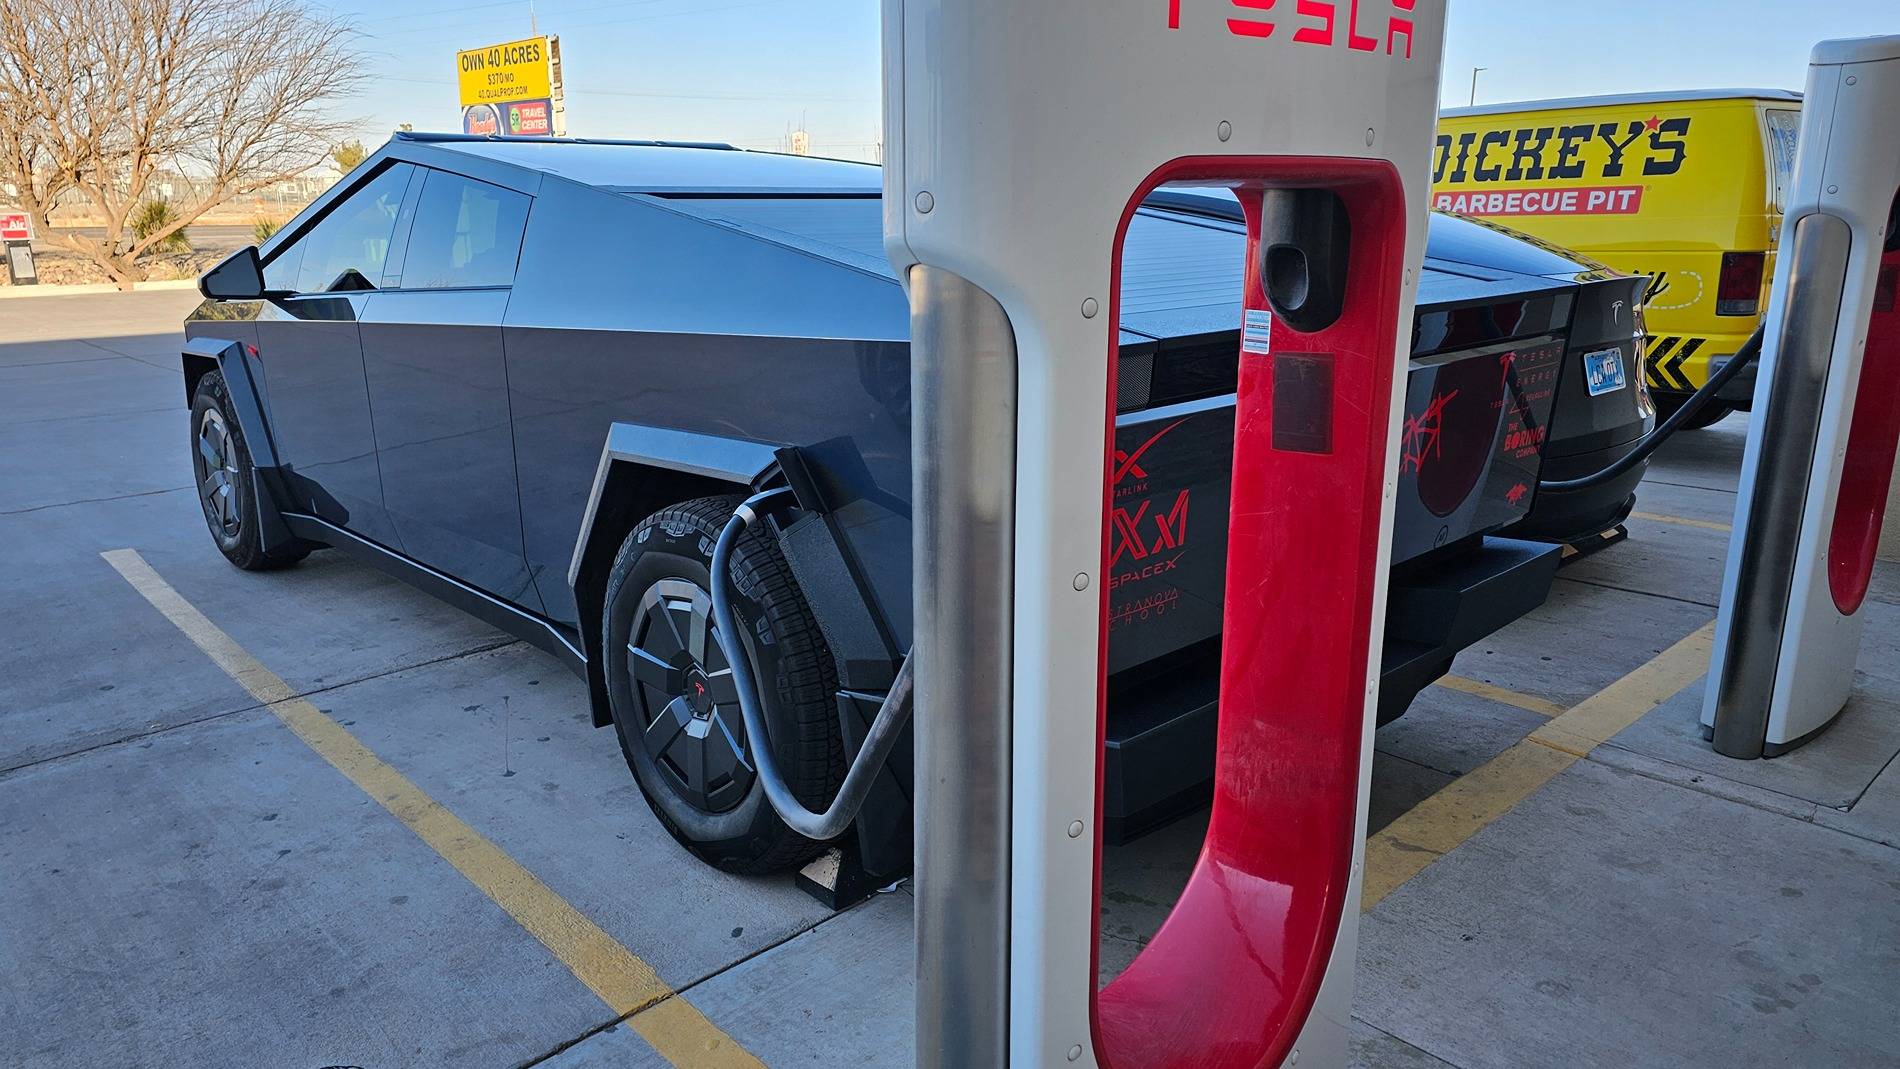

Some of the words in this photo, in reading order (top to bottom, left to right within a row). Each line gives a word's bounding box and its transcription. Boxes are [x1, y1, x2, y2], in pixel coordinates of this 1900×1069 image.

[462, 54, 485, 72] OWN
[488, 49, 501, 68] 40
[503, 44, 540, 66] ACRES
[521, 107, 547, 119] TRAVEL
[521, 119, 548, 130] CENTER
[1437, 191, 1579, 213] BARBECUE
[1587, 190, 1636, 211] PIT
[9, 221, 26, 230] Air
[1508, 423, 1520, 432] THE
[1504, 425, 1545, 452] BORING
[1114, 482, 1149, 497] ARLINK
[1109, 552, 1183, 590] SPACEX
